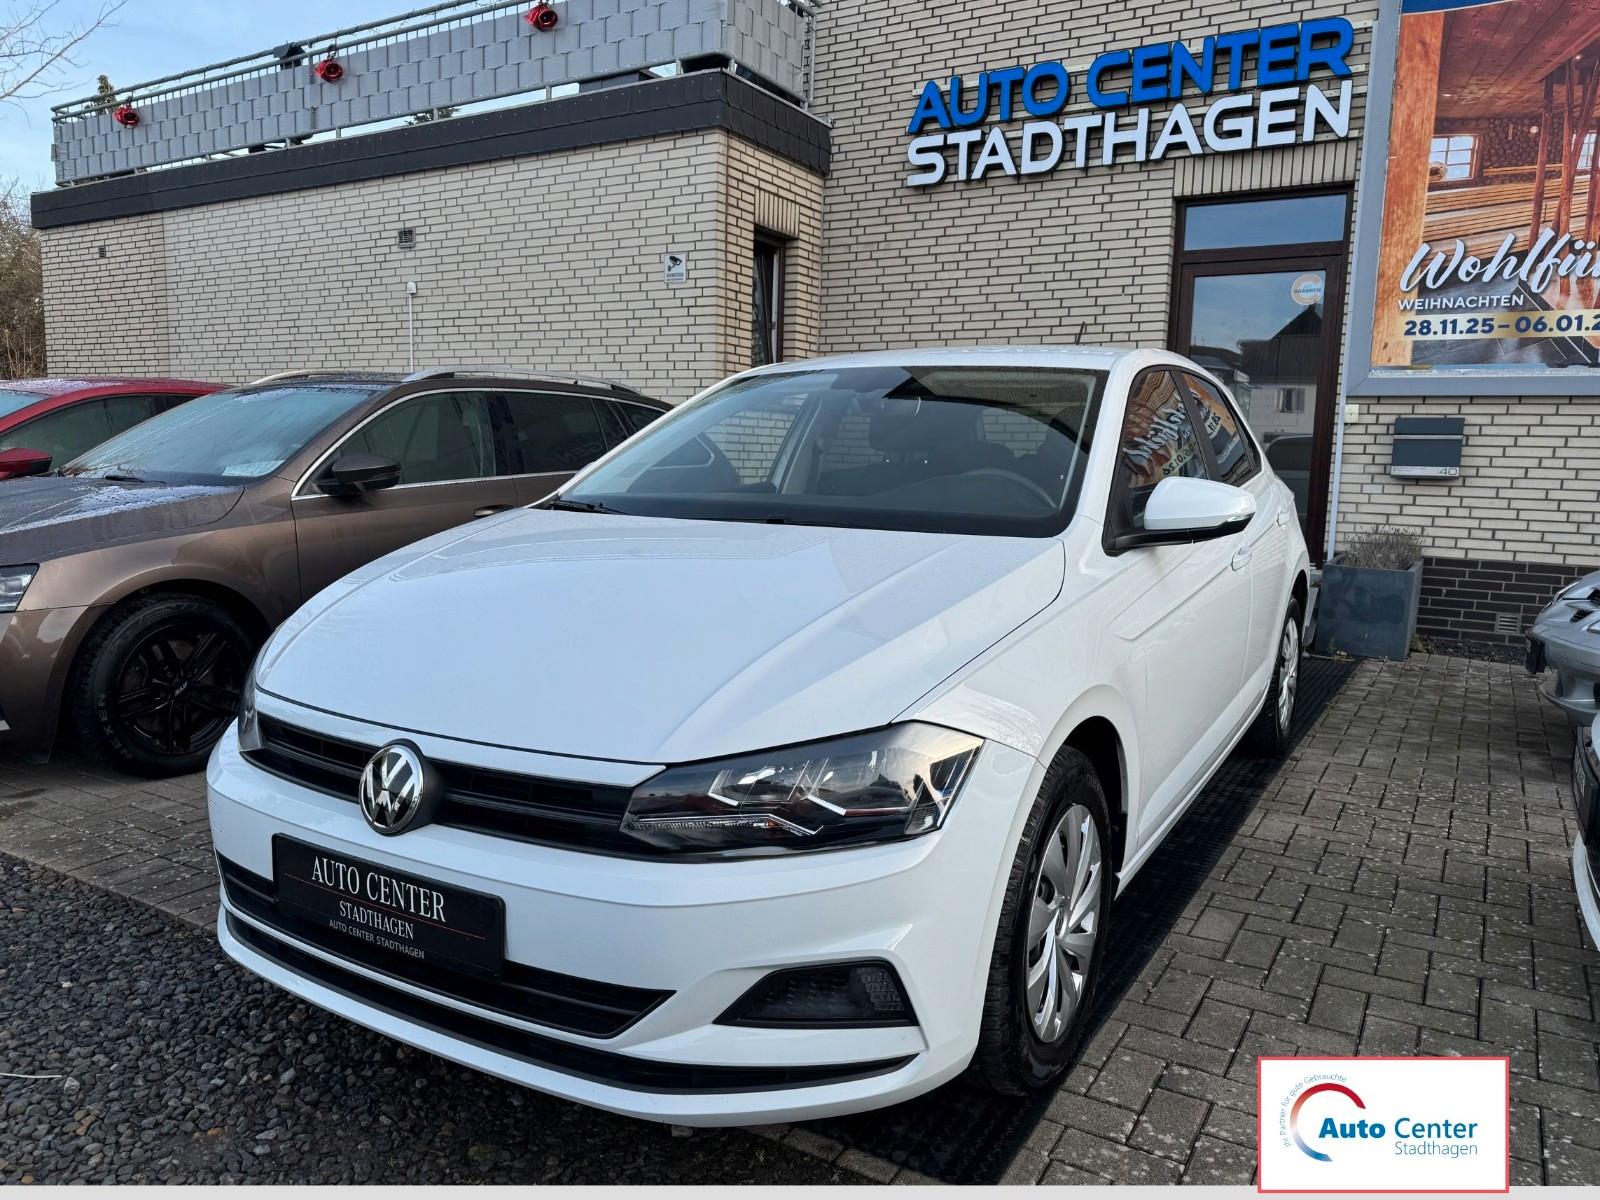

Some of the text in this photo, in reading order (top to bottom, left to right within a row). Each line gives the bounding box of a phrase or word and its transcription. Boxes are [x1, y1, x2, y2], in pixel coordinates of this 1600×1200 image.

[908, 17, 1355, 134] AUTO CENTER
[907, 79, 1353, 187] STADTHAGEN
[1398, 294, 1524, 311] WEIHNACHTEN
[1439, 467, 1458, 476] 40
[311, 855, 447, 923] AUTO CENTER
[329, 919, 425, 959] AUTO CENTER STADTHAGEN
[339, 900, 415, 941] STADTHAGEN
